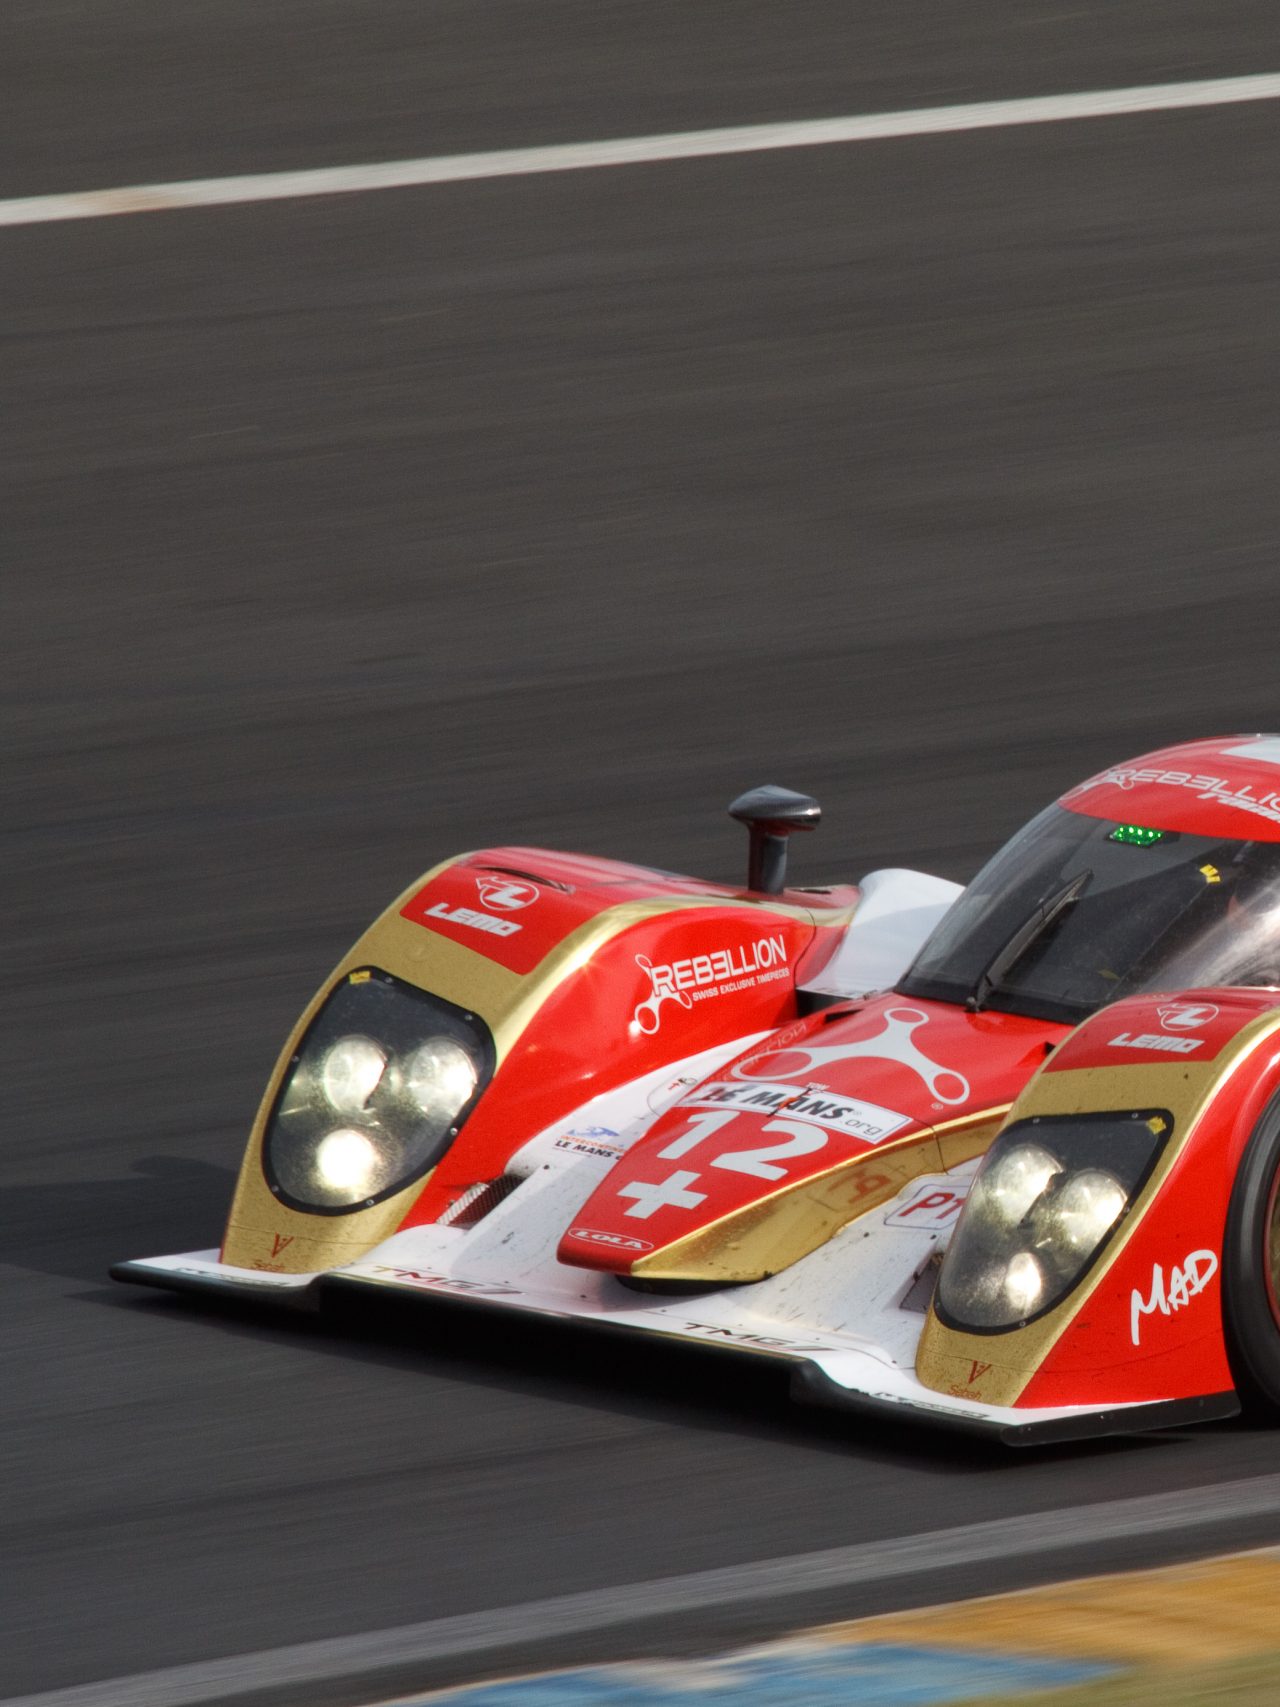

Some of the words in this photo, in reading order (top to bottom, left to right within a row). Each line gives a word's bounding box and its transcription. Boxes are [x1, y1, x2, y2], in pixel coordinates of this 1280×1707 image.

[425, 902, 523, 937] LEMO
[650, 934, 788, 997] REBELLION
[692, 986, 719, 1001] SWISS
[720, 977, 756, 995] EXCLUSIVE
[757, 967, 790, 985] TIMEPIECES
[1107, 1031, 1205, 1054] LEMO
[555, 1140, 571, 1149] LE
[572, 1144, 614, 1158] MANS
[656, 1110, 829, 1181] 12
[575, 1230, 644, 1251] LOLA
[1130, 1249, 1218, 1346] MAD
[682, 1321, 798, 1347] TMG
